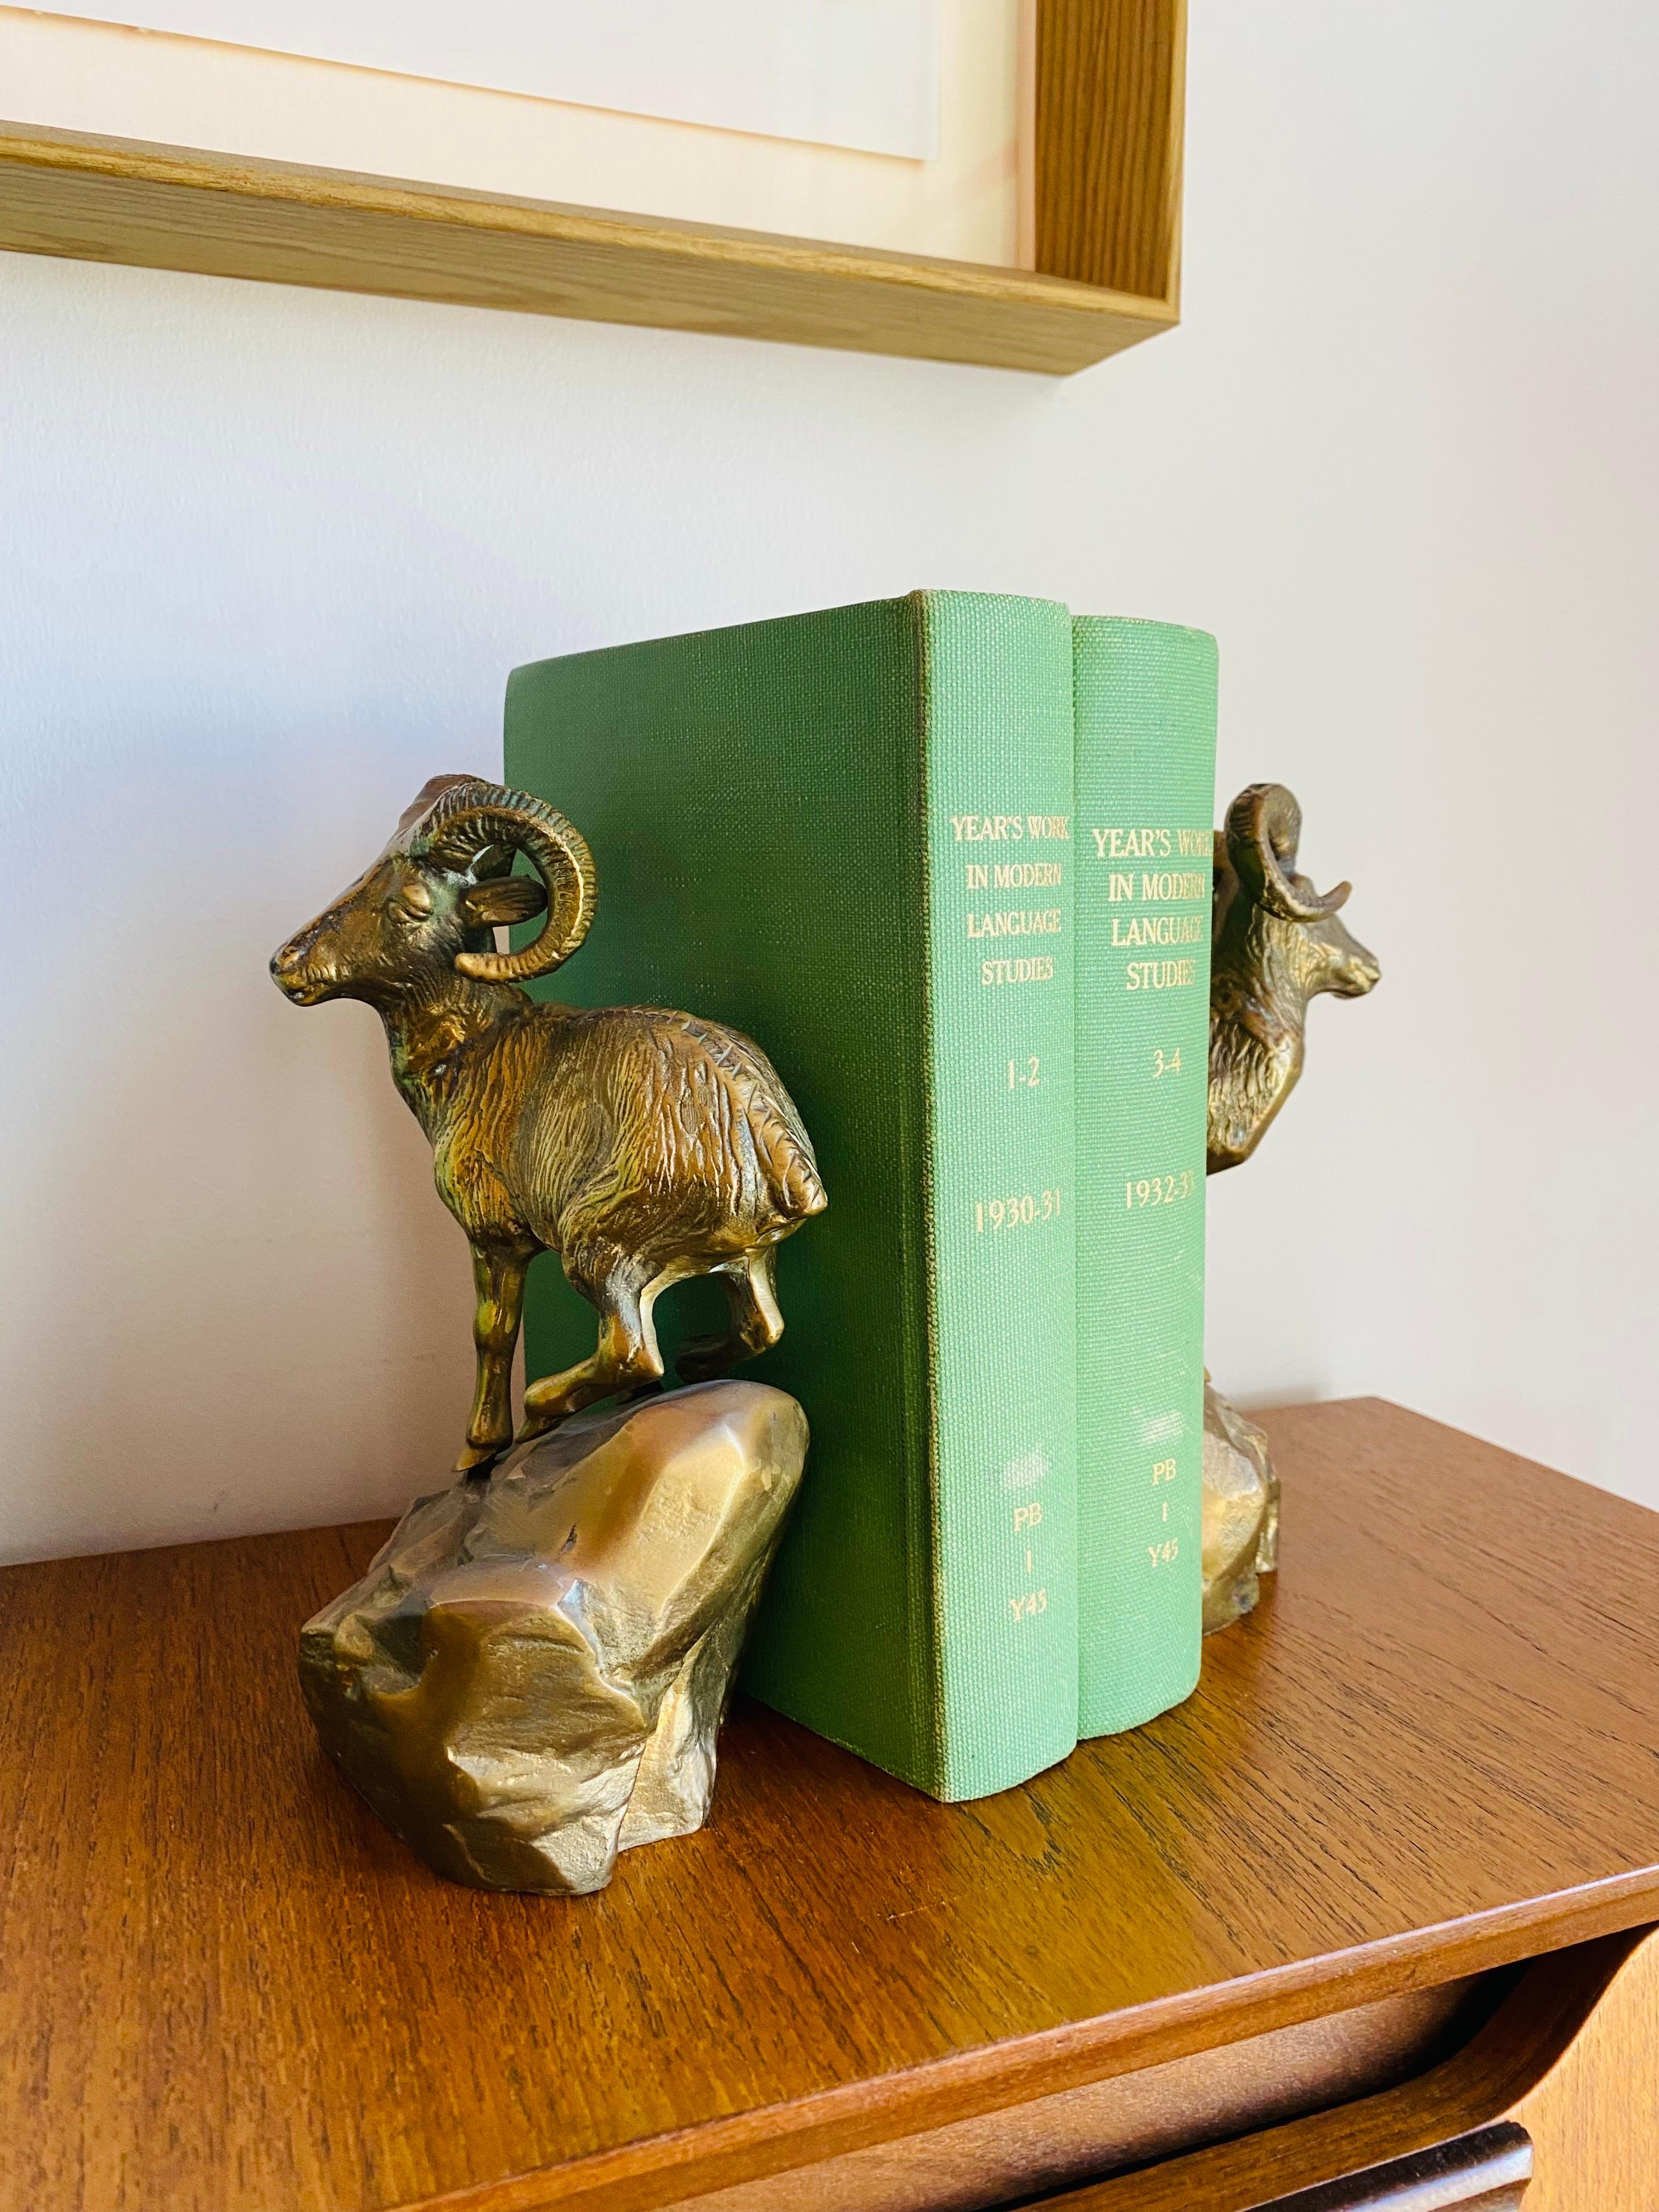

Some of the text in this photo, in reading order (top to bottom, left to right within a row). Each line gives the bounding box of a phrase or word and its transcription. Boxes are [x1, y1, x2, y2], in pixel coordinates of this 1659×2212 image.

[952, 815, 1070, 842] YEAR'S WORK
[1092, 828, 1171, 857] YEAR'S
[966, 863, 1062, 889] IN MODERN
[1108, 872, 1205, 902] IN MODERN
[968, 909, 1062, 939] LANGUAGE
[1111, 915, 1203, 946] LANGUAGE
[981, 956, 1054, 986] STUDIES
[1007, 1056, 1040, 1090] 1-2
[1152, 1047, 1182, 1077] 3-4
[975, 1187, 1061, 1232] 1930-31
[1152, 1458, 1177, 1486] PB
[1013, 1502, 1042, 1532] PB
[1147, 1536, 1178, 1568] Y45
[1009, 1587, 1047, 1622] Y45
